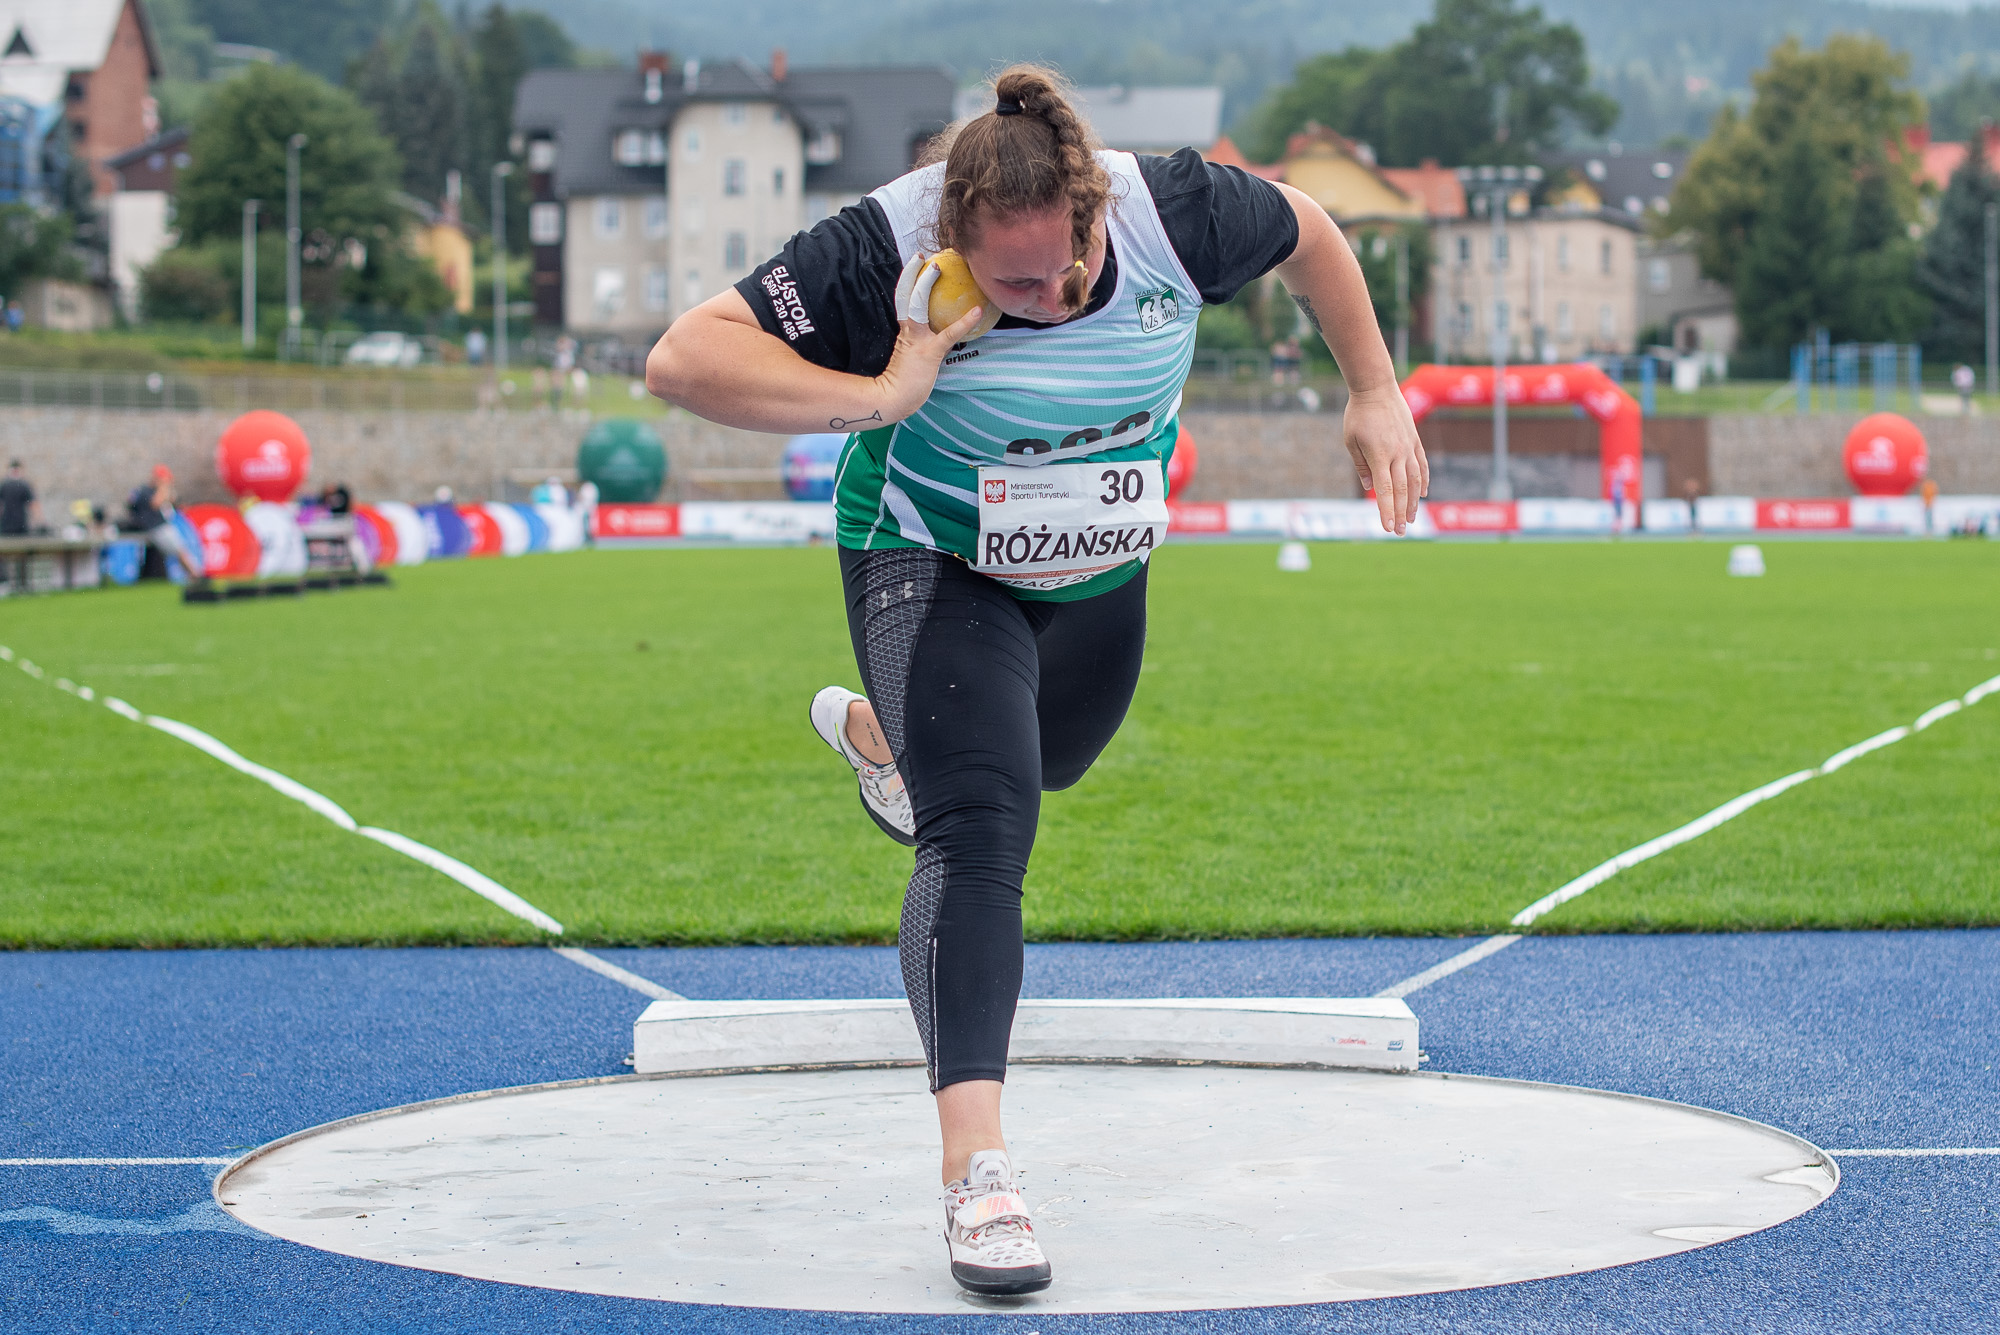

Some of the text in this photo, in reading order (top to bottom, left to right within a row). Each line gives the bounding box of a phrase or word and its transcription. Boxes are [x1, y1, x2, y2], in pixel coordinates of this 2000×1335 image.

[772, 298, 788, 319] 230
[782, 320, 799, 341] 486
[1144, 314, 1159, 331] AZS
[945, 349, 980, 366] erima
[1010, 482, 1054, 491] Ministerstwo
[1099, 468, 1144, 505] 30
[1010, 492, 1034, 501] Sportu
[1038, 490, 1070, 500] Turystyki
[984, 523, 1155, 566] RÓŻAŃSKA
